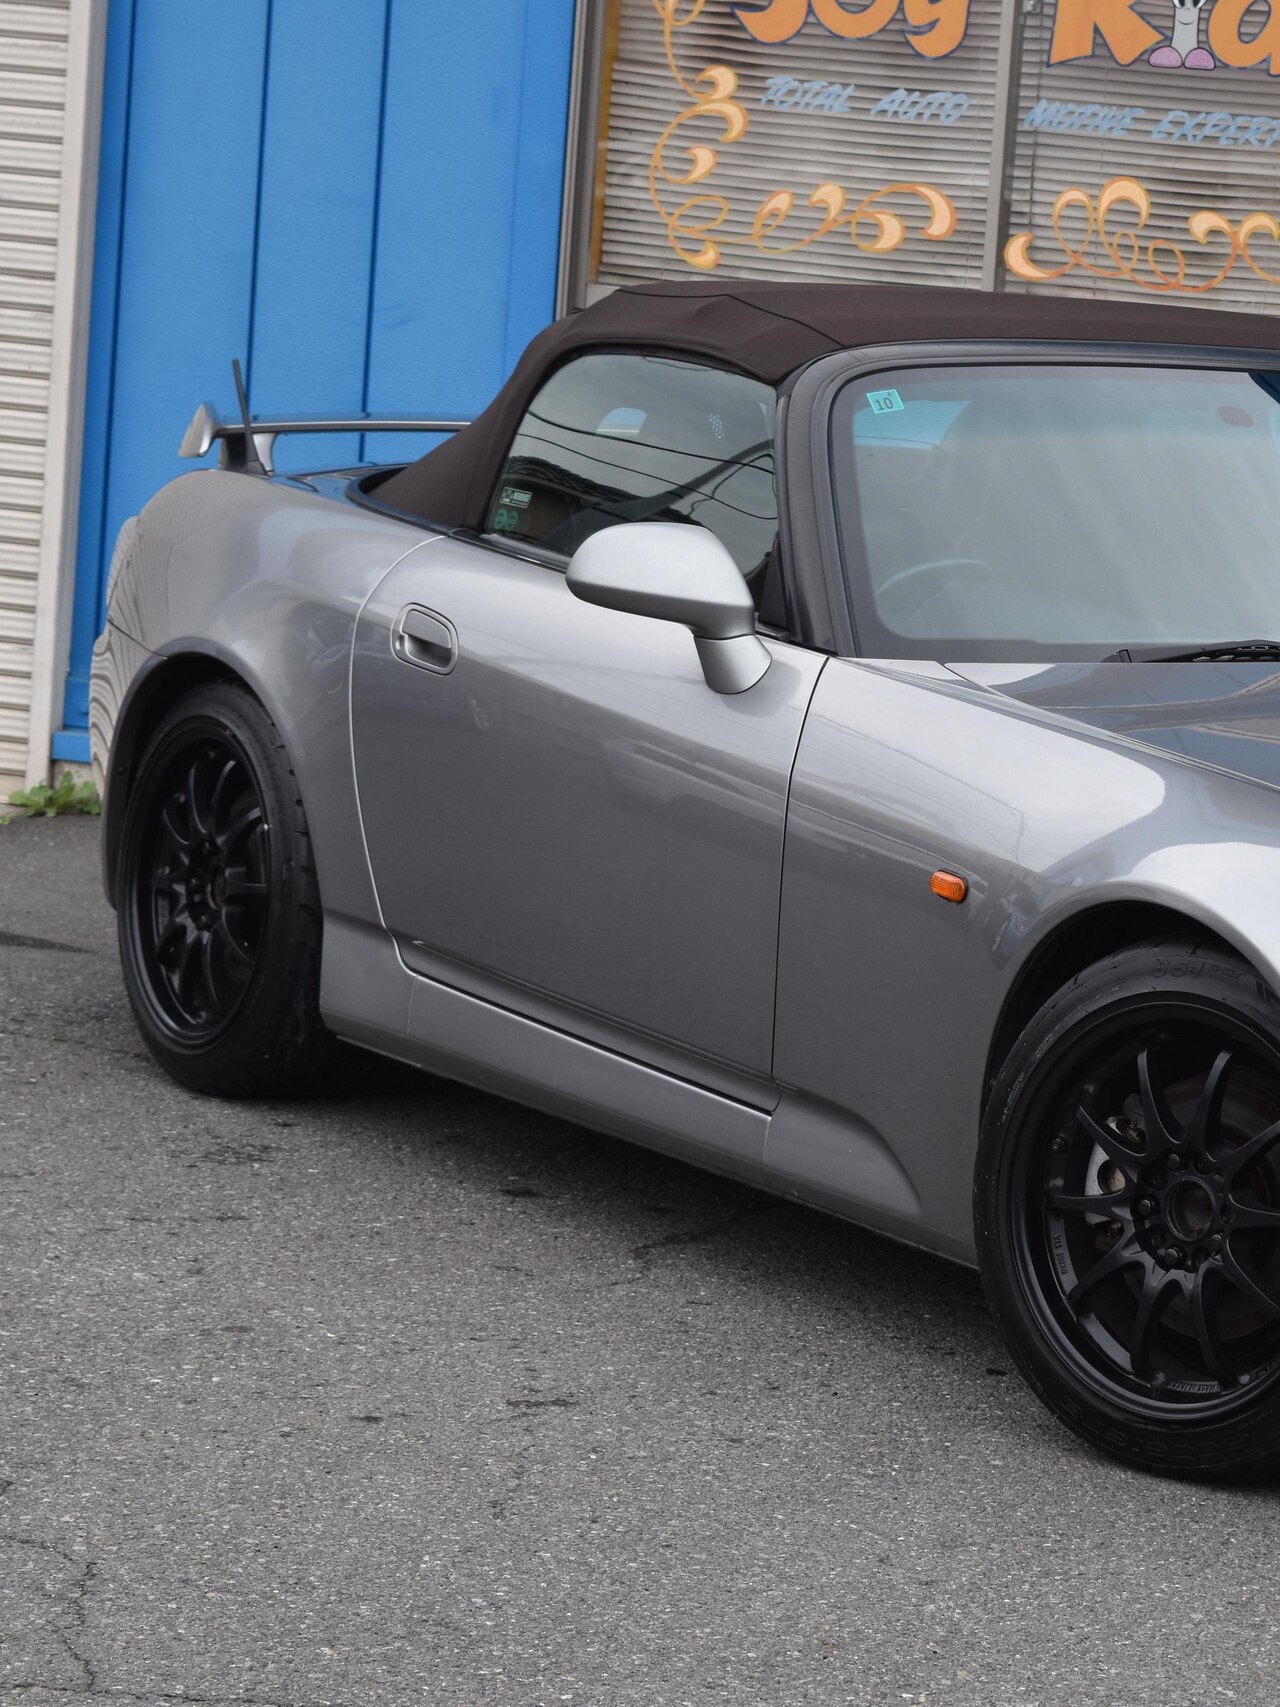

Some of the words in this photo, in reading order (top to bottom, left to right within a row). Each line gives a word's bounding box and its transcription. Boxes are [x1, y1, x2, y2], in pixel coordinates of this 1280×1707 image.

[761, 75, 855, 113] TOTAL
[870, 87, 970, 124] AUTO
[1023, 98, 1146, 136] MOTIVE
[875, 397, 894, 411] 10
